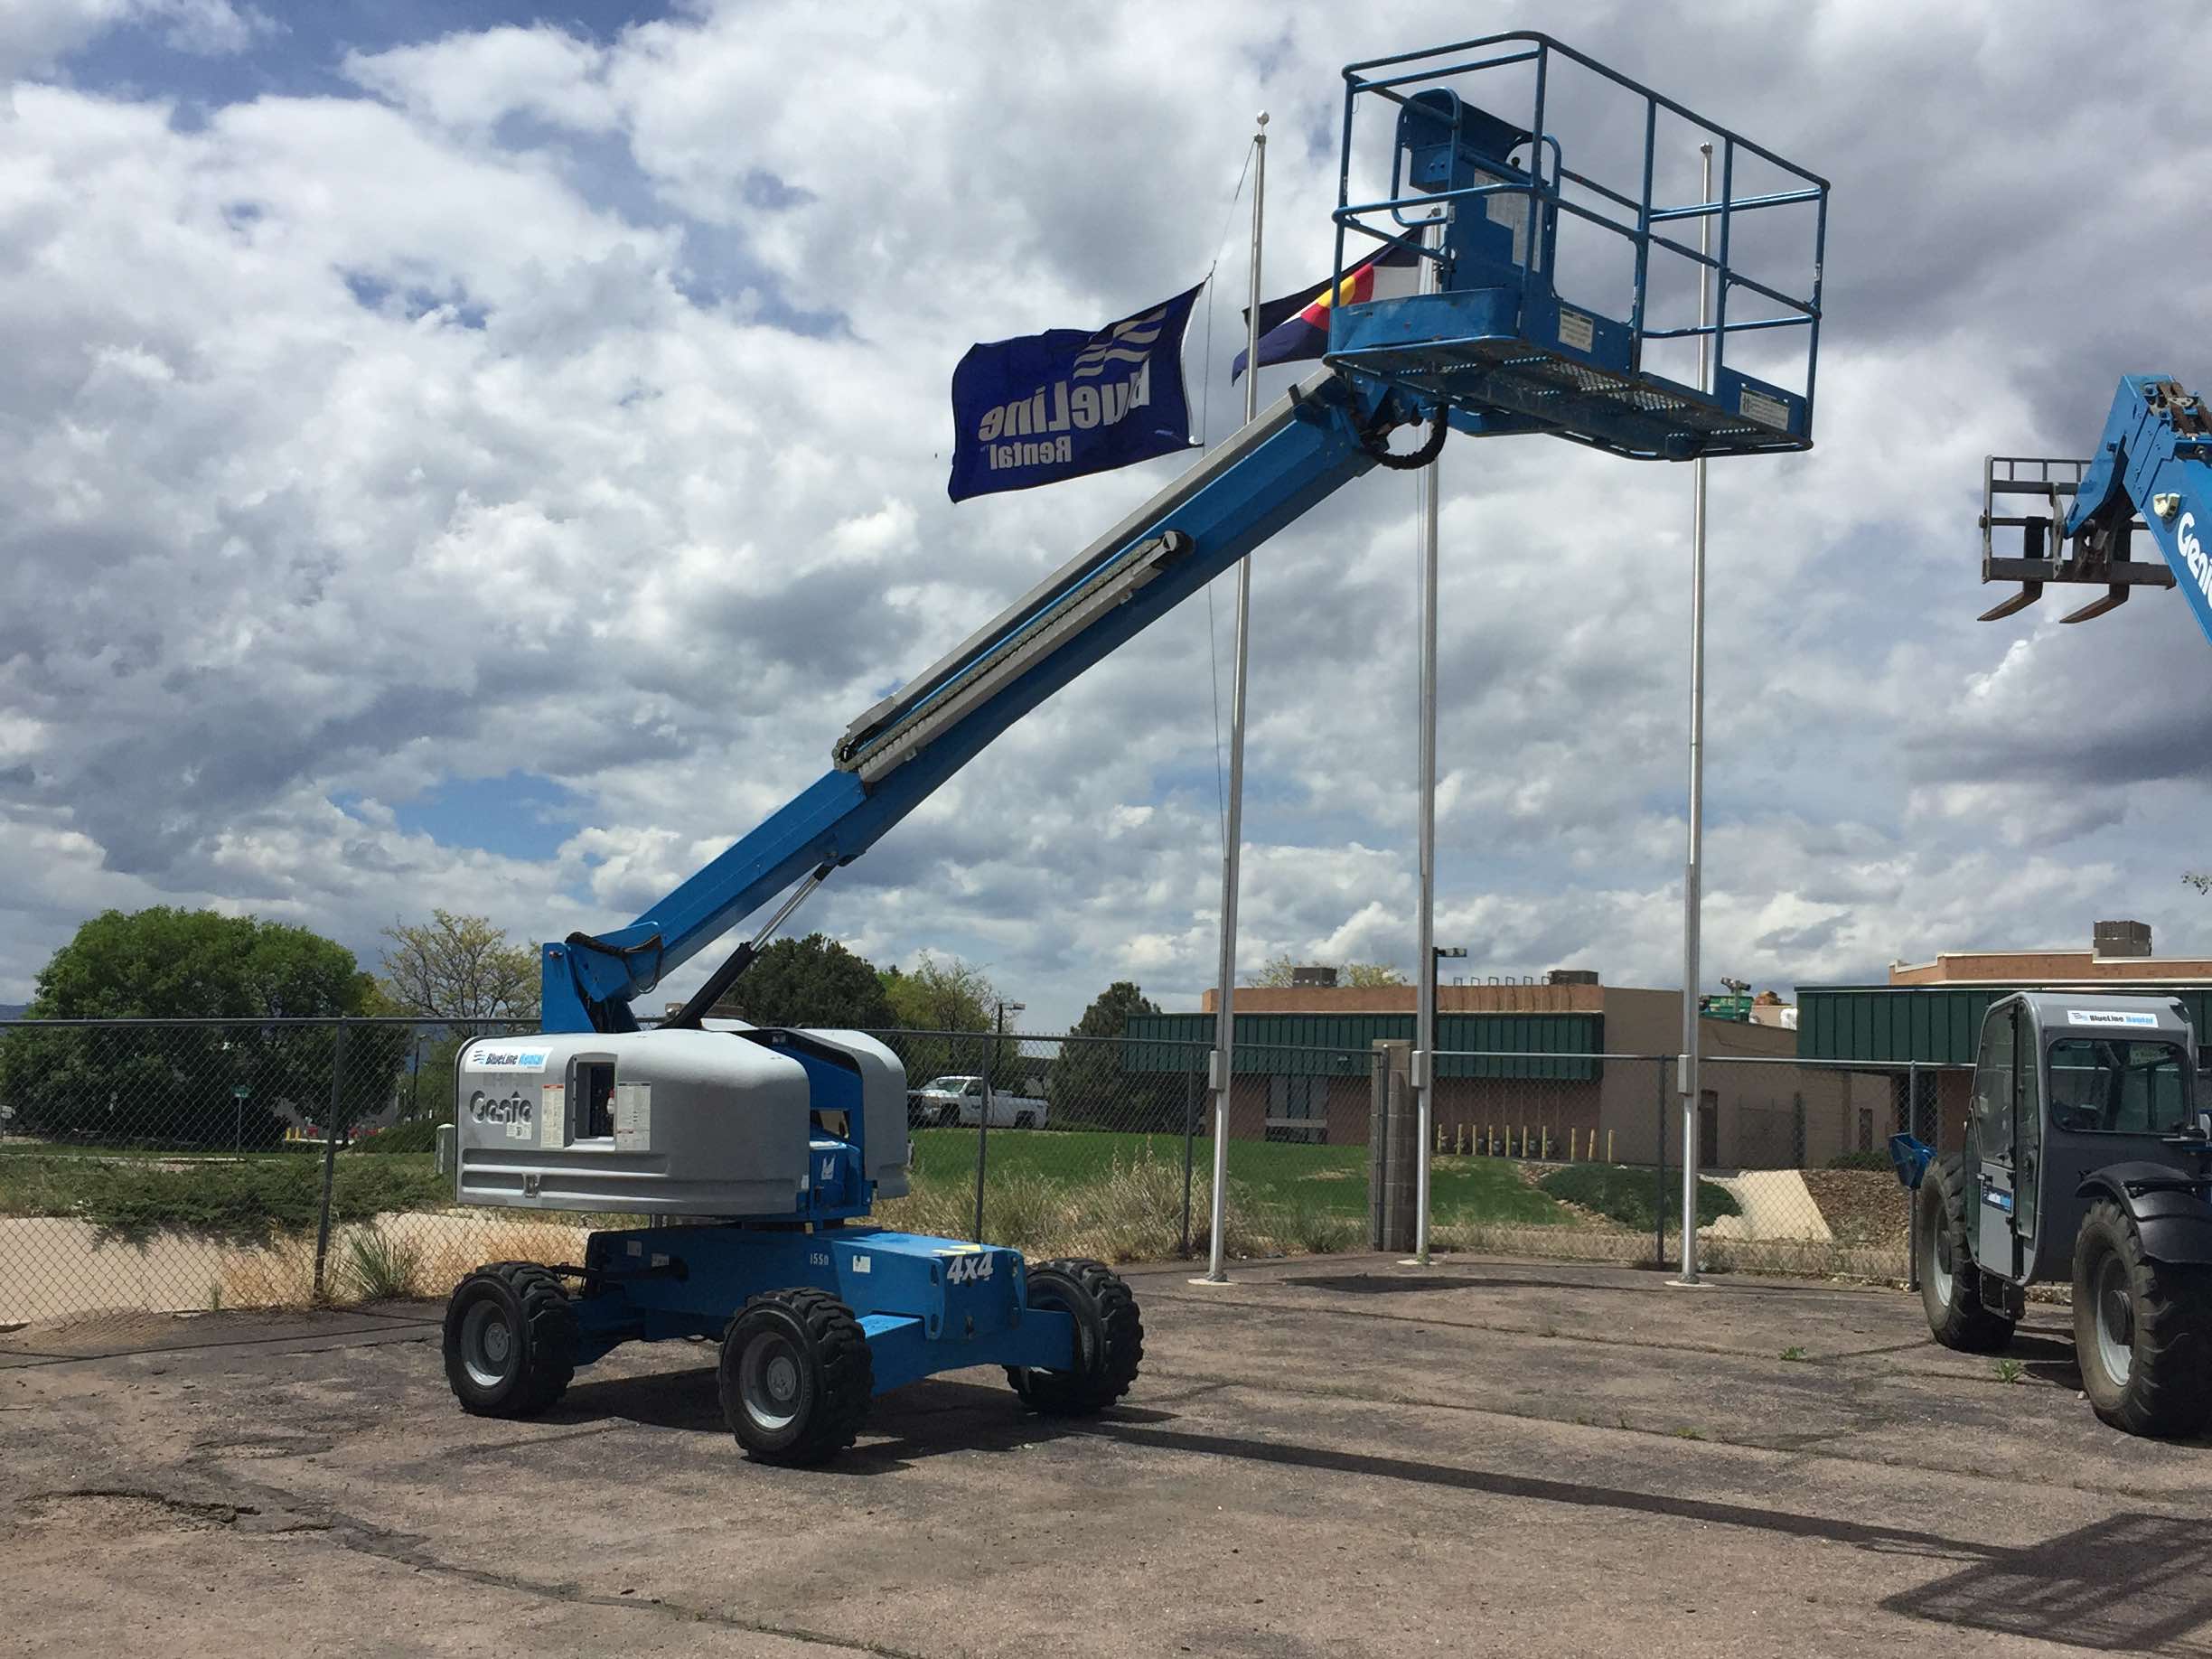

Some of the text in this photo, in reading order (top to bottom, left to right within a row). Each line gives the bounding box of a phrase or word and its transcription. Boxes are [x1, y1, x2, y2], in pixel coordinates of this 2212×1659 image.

[2178, 511, 2212, 609] Geni
[469, 1090, 532, 1124] Genie
[946, 1252, 994, 1284] 4x4
